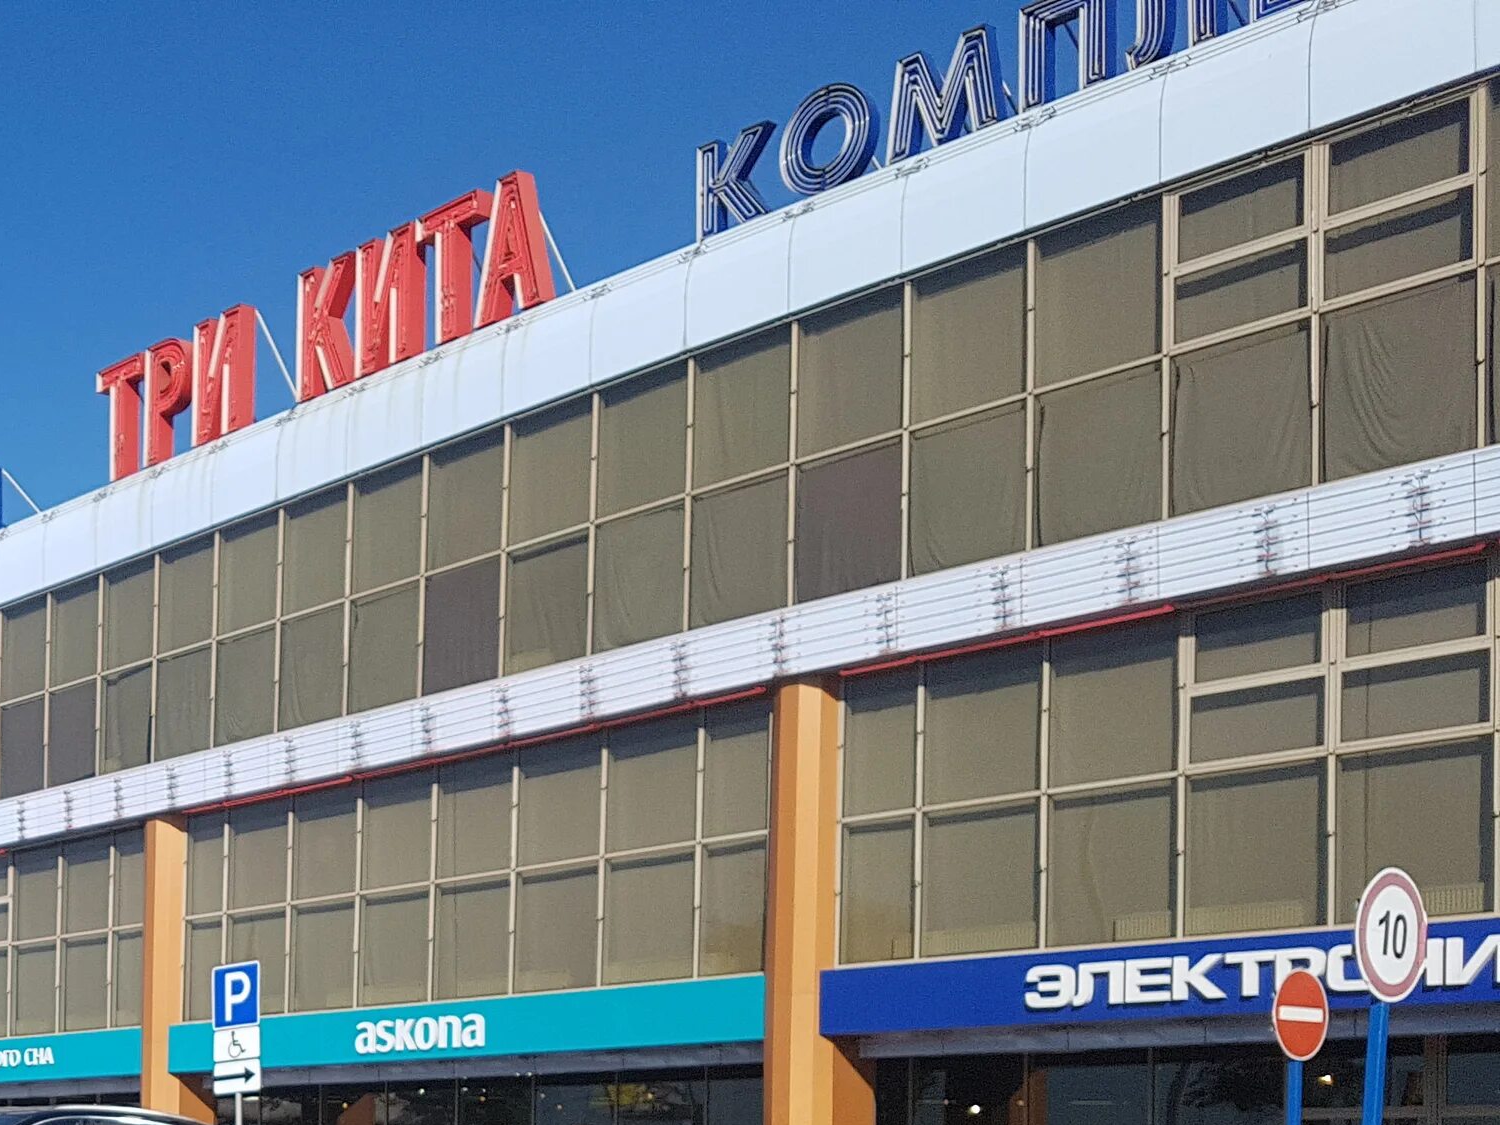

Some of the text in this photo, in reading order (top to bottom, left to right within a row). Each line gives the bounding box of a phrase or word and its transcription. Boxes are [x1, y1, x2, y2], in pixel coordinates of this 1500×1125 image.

[696, 0, 1308, 241] КОМПЛ
[96, 169, 555, 482] ТРИ КИТА
[1378, 909, 1408, 959] 10
[223, 970, 252, 1023] P
[23, 1046, 55, 1066] СНА
[355, 1012, 486, 1055] askona
